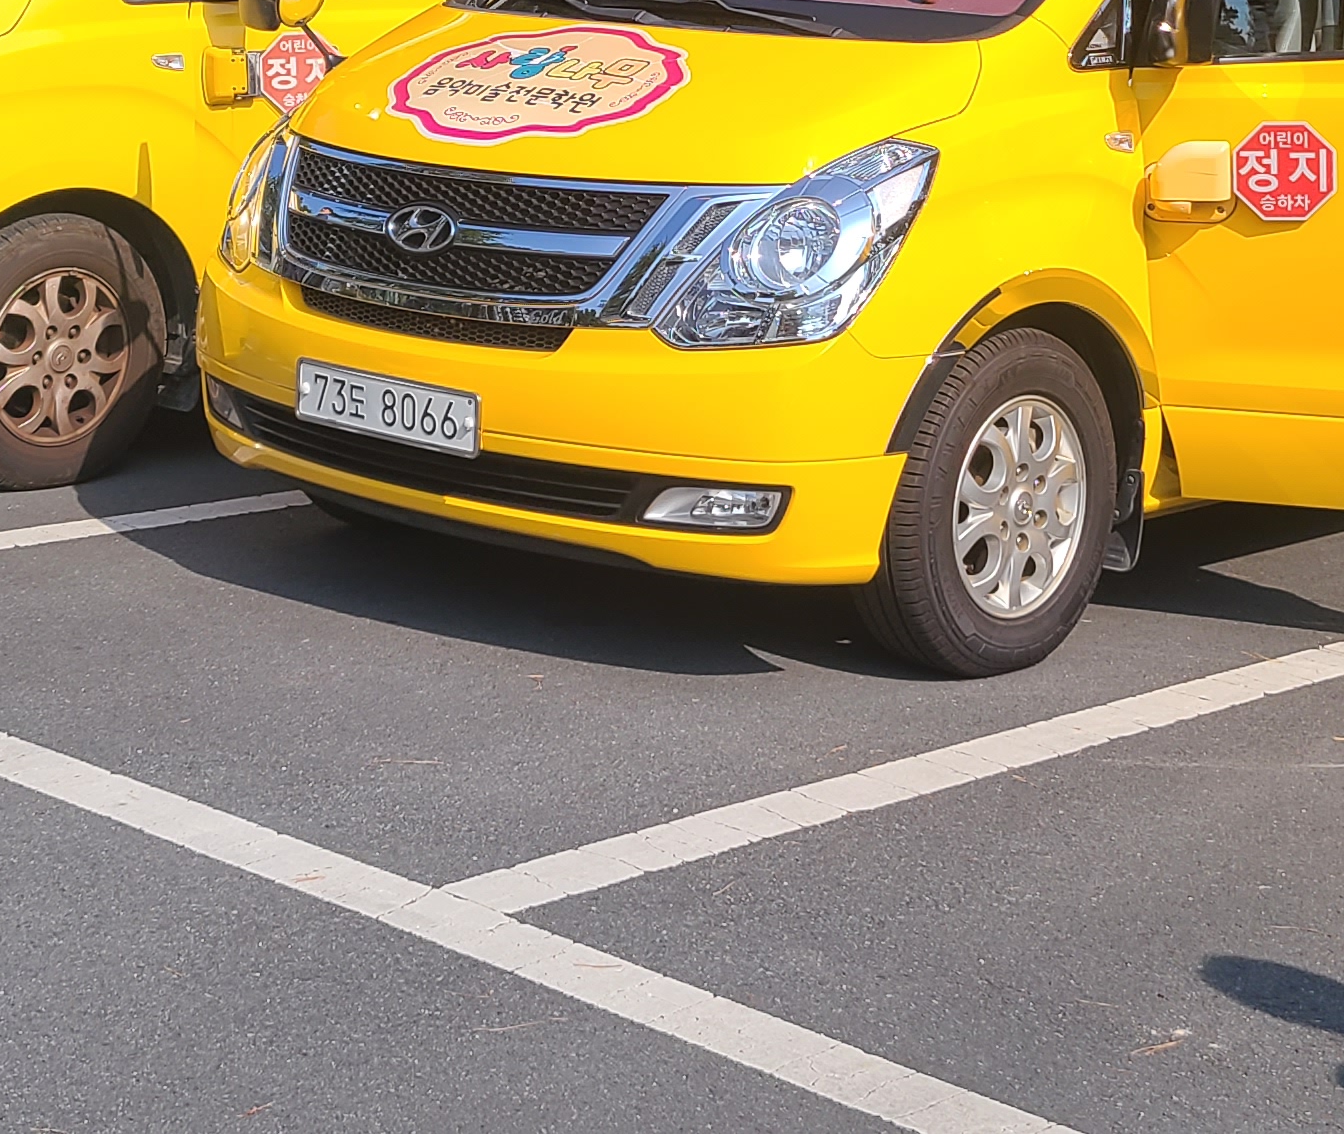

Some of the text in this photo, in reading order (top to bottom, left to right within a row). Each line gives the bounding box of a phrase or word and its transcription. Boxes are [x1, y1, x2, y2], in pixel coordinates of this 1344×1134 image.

[455, 45, 651, 90] 사랑나무
[421, 76, 603, 114] 음악미술전문학원
[1259, 131, 1309, 149] 어린이
[1259, 193, 1311, 211] 승하차
[530, 309, 568, 325] Gold
[314, 373, 458, 440] 73도 8066
